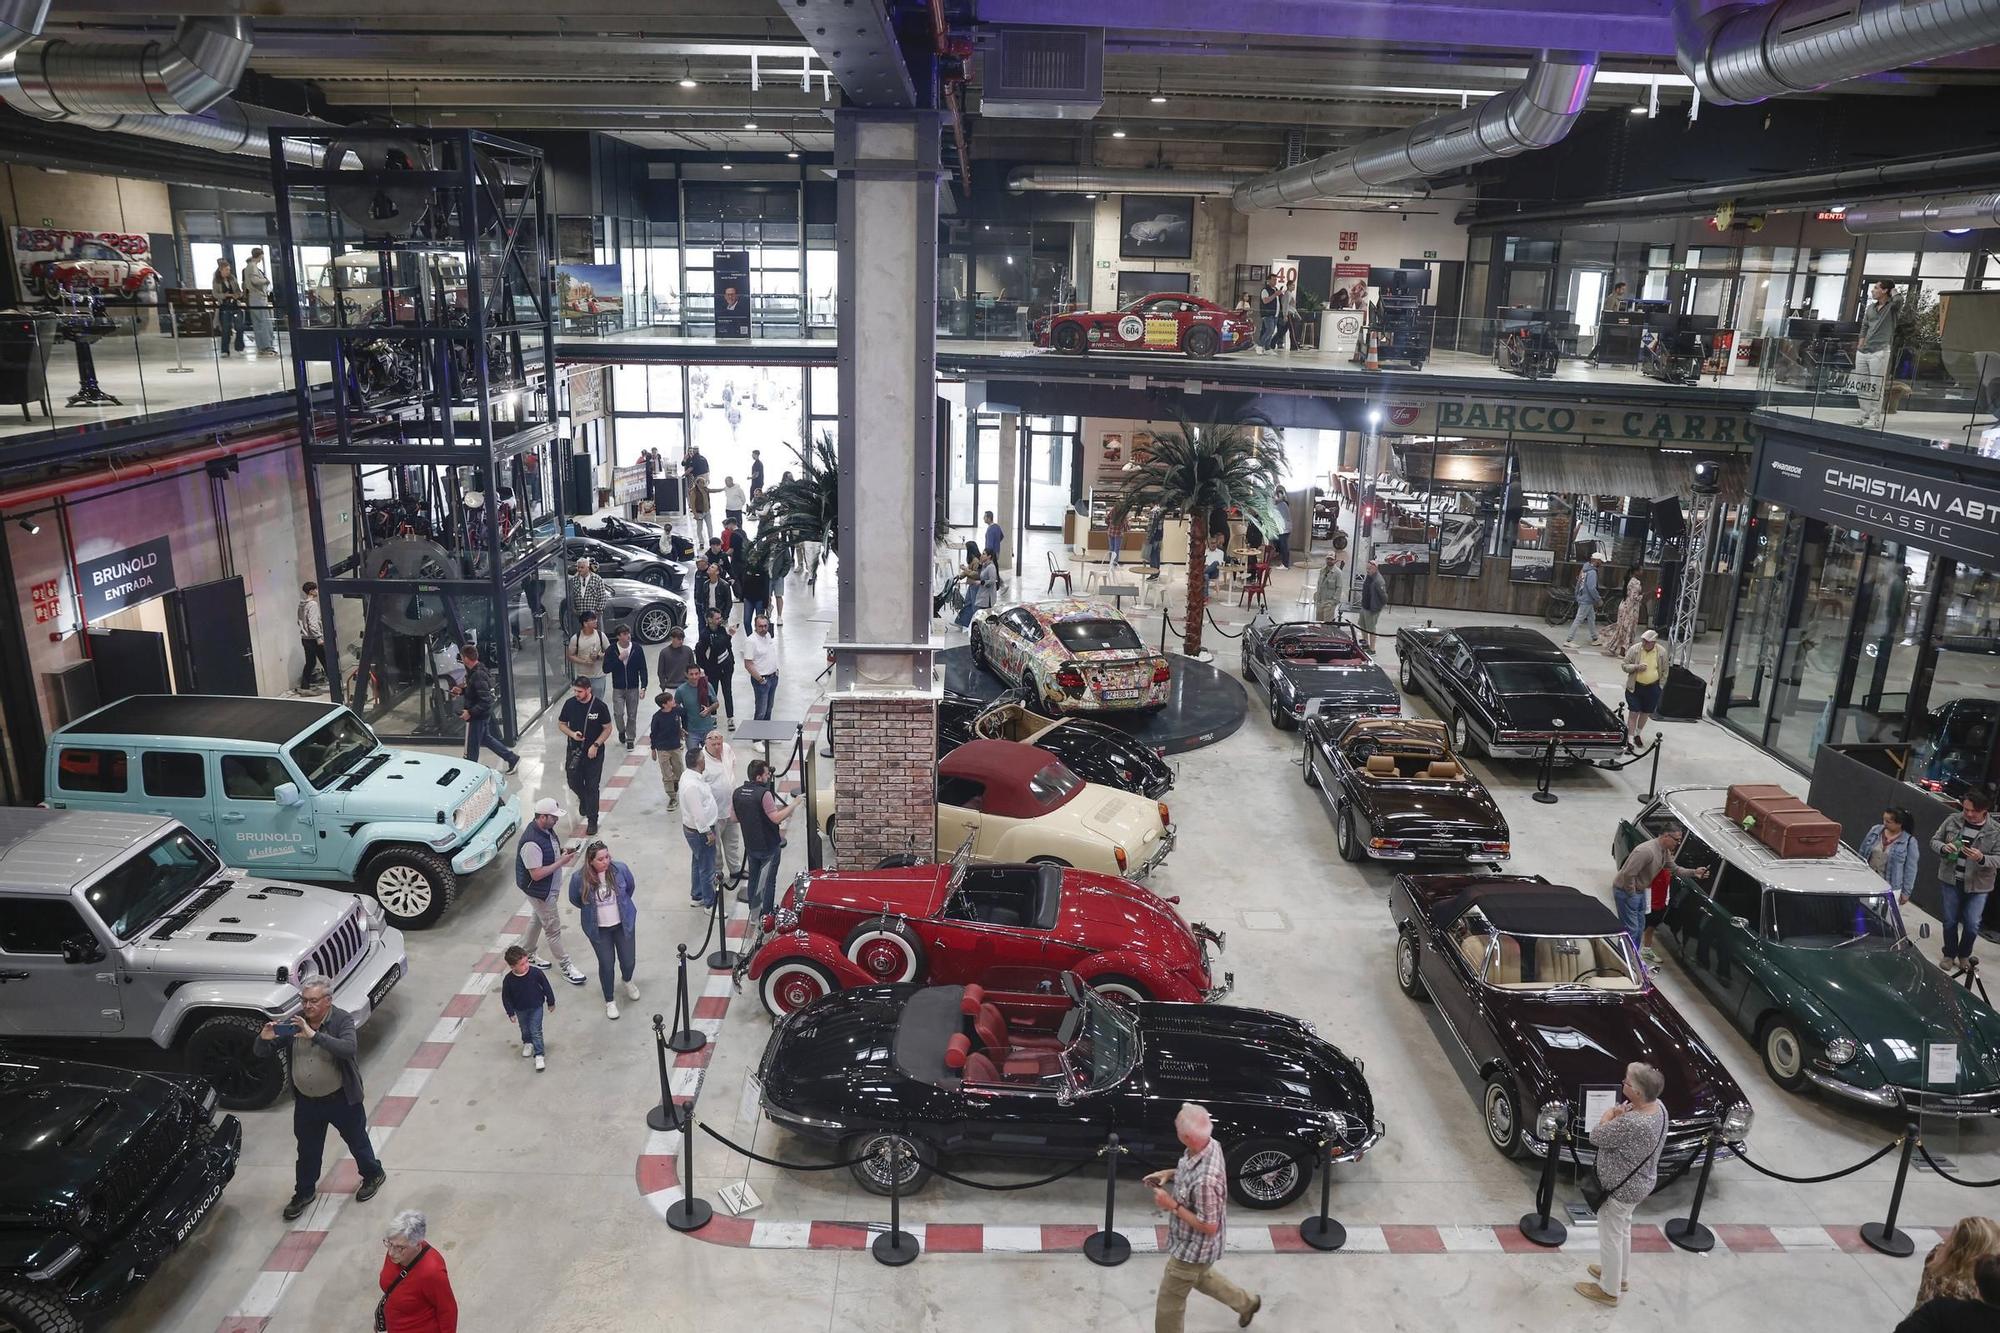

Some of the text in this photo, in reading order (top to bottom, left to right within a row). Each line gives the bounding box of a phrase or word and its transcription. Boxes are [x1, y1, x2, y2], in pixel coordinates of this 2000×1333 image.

[1818, 212, 1846, 220] BENTL
[1276, 267, 1297, 283] 40
[1125, 326, 1139, 335] 604
[1846, 380, 1877, 393] YACHTS
[1440, 402, 1576, 433] BARCO
[1825, 468, 1941, 510] CHRISTIAN
[1855, 504, 1951, 538] CLASSIC
[92, 552, 158, 587] BRUNOLD
[104, 575, 154, 601] ENTRADA
[236, 832, 302, 842] BRUNOLD
[373, 969, 400, 1004] BRUNOLD
[177, 1184, 220, 1241] BRUNOLD
